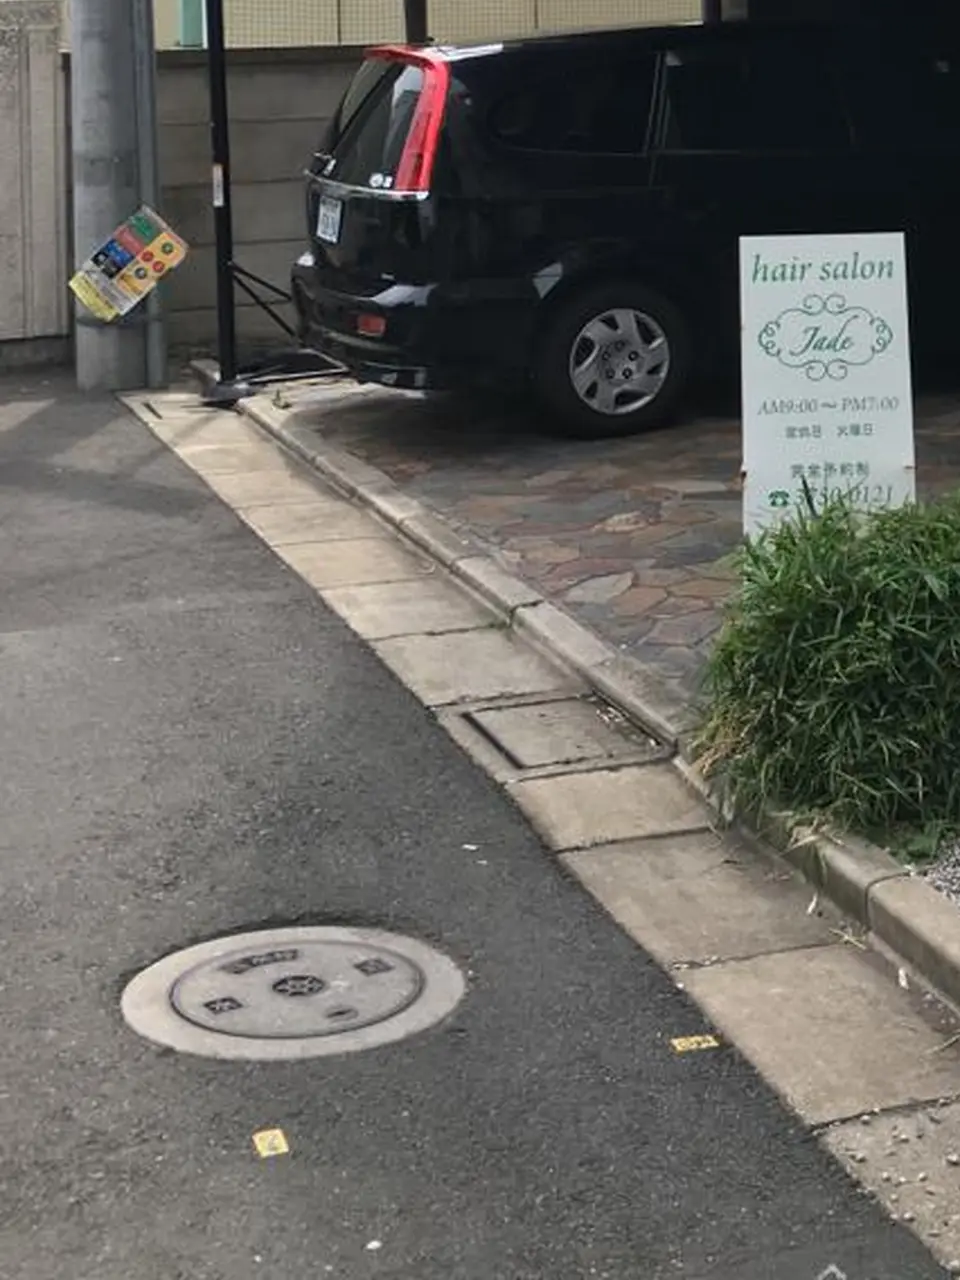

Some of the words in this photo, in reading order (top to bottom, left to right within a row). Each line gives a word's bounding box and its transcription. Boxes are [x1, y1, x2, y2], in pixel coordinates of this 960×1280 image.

[751, 253, 813, 284] hair
[818, 251, 894, 281] salon
[789, 314, 858, 357] Jade
